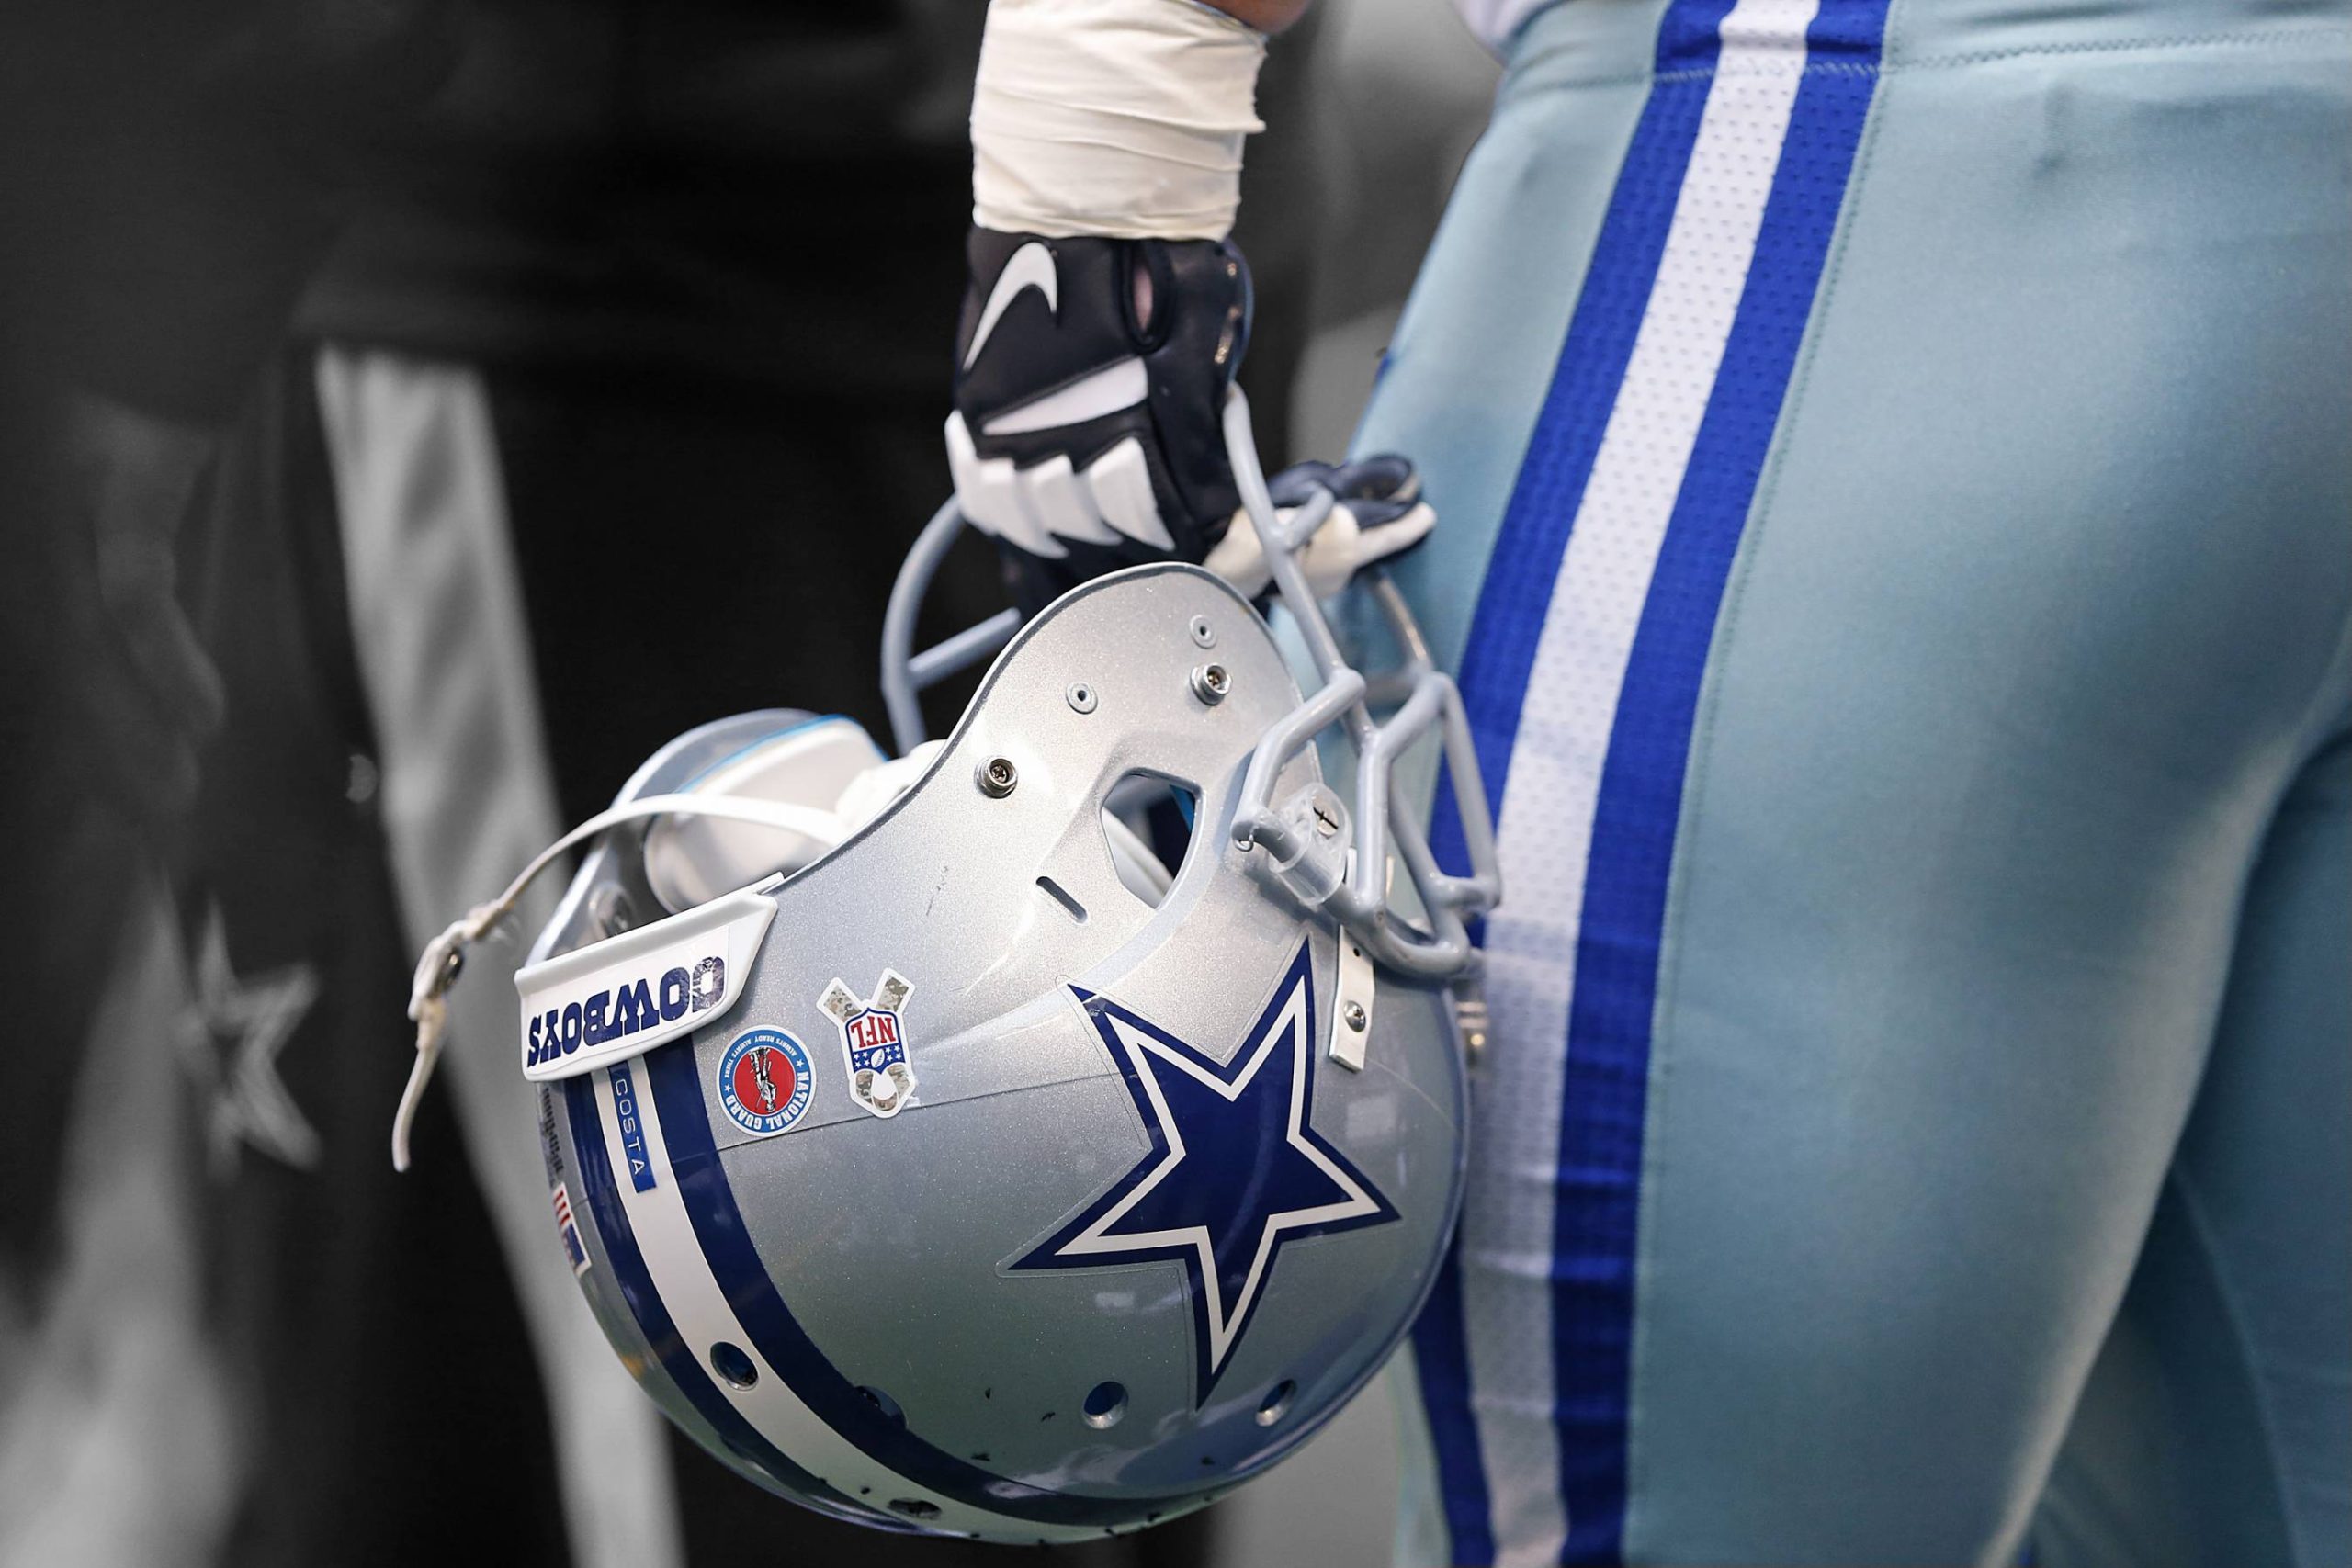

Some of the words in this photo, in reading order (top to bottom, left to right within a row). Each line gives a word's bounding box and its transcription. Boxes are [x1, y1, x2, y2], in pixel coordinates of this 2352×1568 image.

[527, 956, 726, 1068] COWBOYS
[731, 1038, 752, 1058] ALWAYS
[754, 1034, 775, 1043] READY
[775, 1038, 797, 1057] ALWAYS
[850, 1015, 897, 1049] NFL
[724, 1058, 734, 1078] THERE
[725, 1094, 763, 1130] GUARD
[765, 1071, 810, 1130] NATIONAL
[616, 1078, 646, 1176] COSTA
